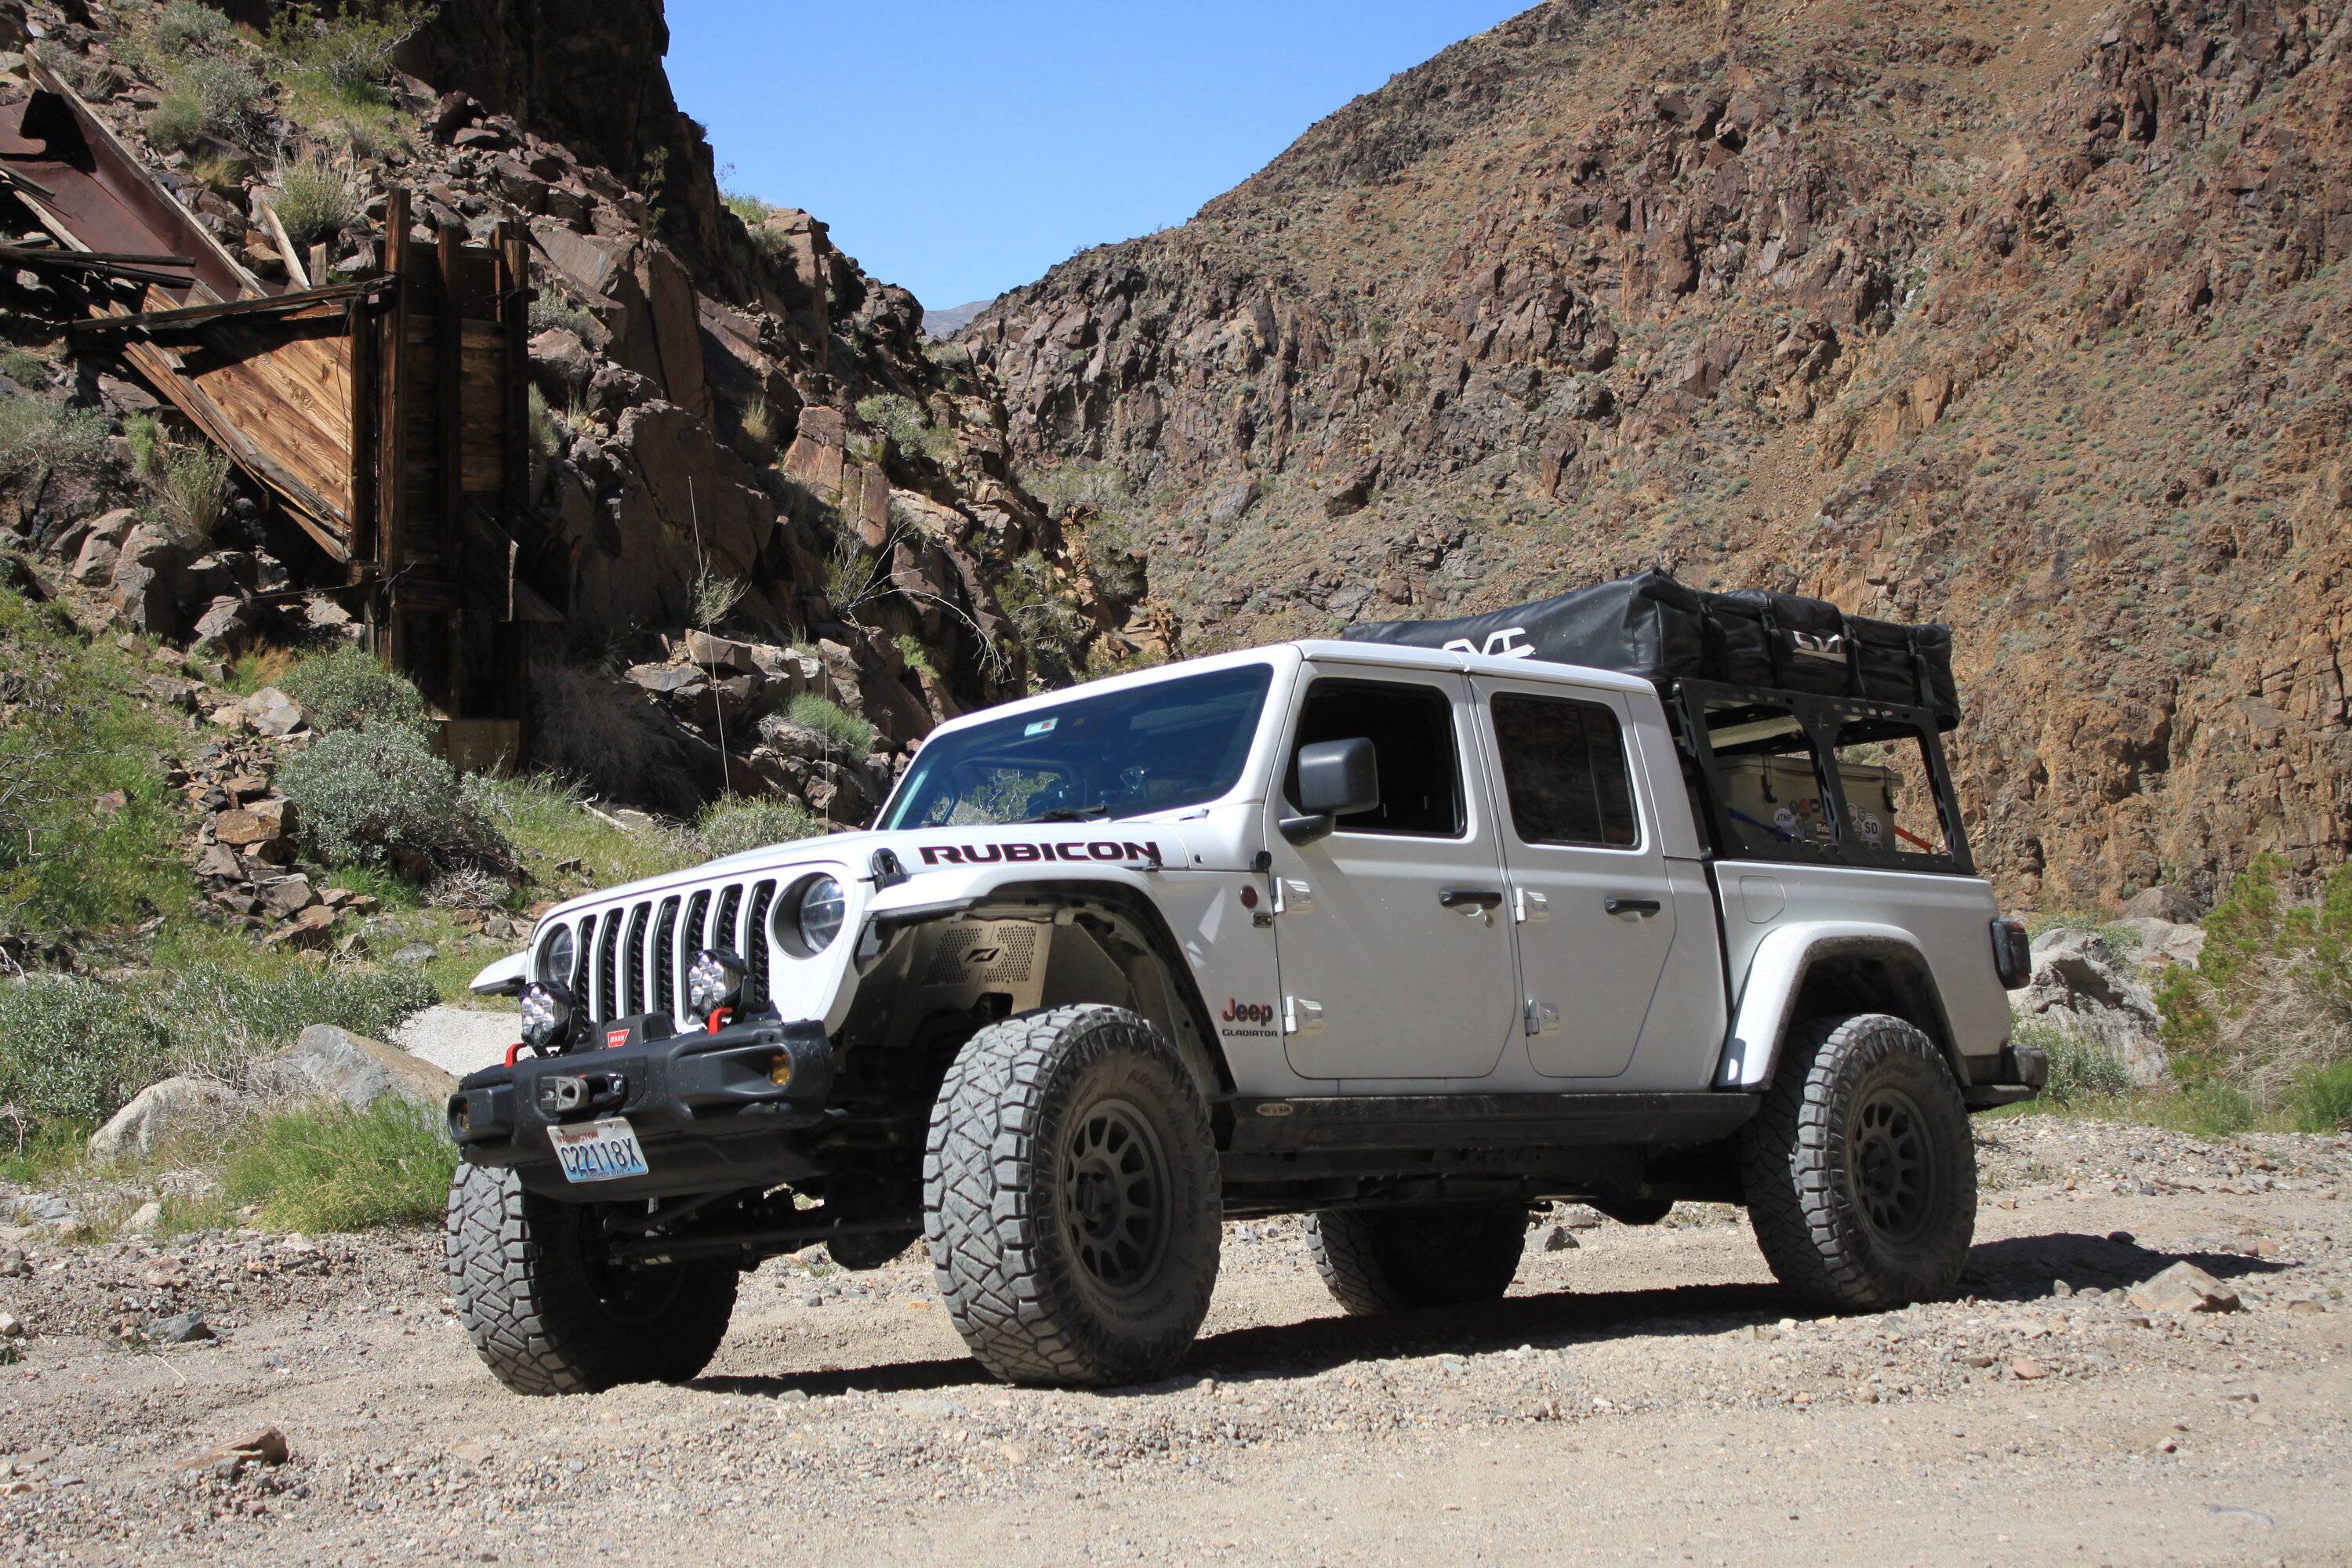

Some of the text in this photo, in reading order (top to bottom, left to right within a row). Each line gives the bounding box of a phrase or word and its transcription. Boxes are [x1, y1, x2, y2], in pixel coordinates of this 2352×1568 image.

[1864, 821, 1878, 835] SD
[918, 841, 1162, 865] RUBICON
[1221, 998, 1273, 1026] Jeep
[610, 1034, 625, 1043] WARN
[556, 1131, 600, 1143] WASHINGTON
[561, 1138, 642, 1175] C22118X
